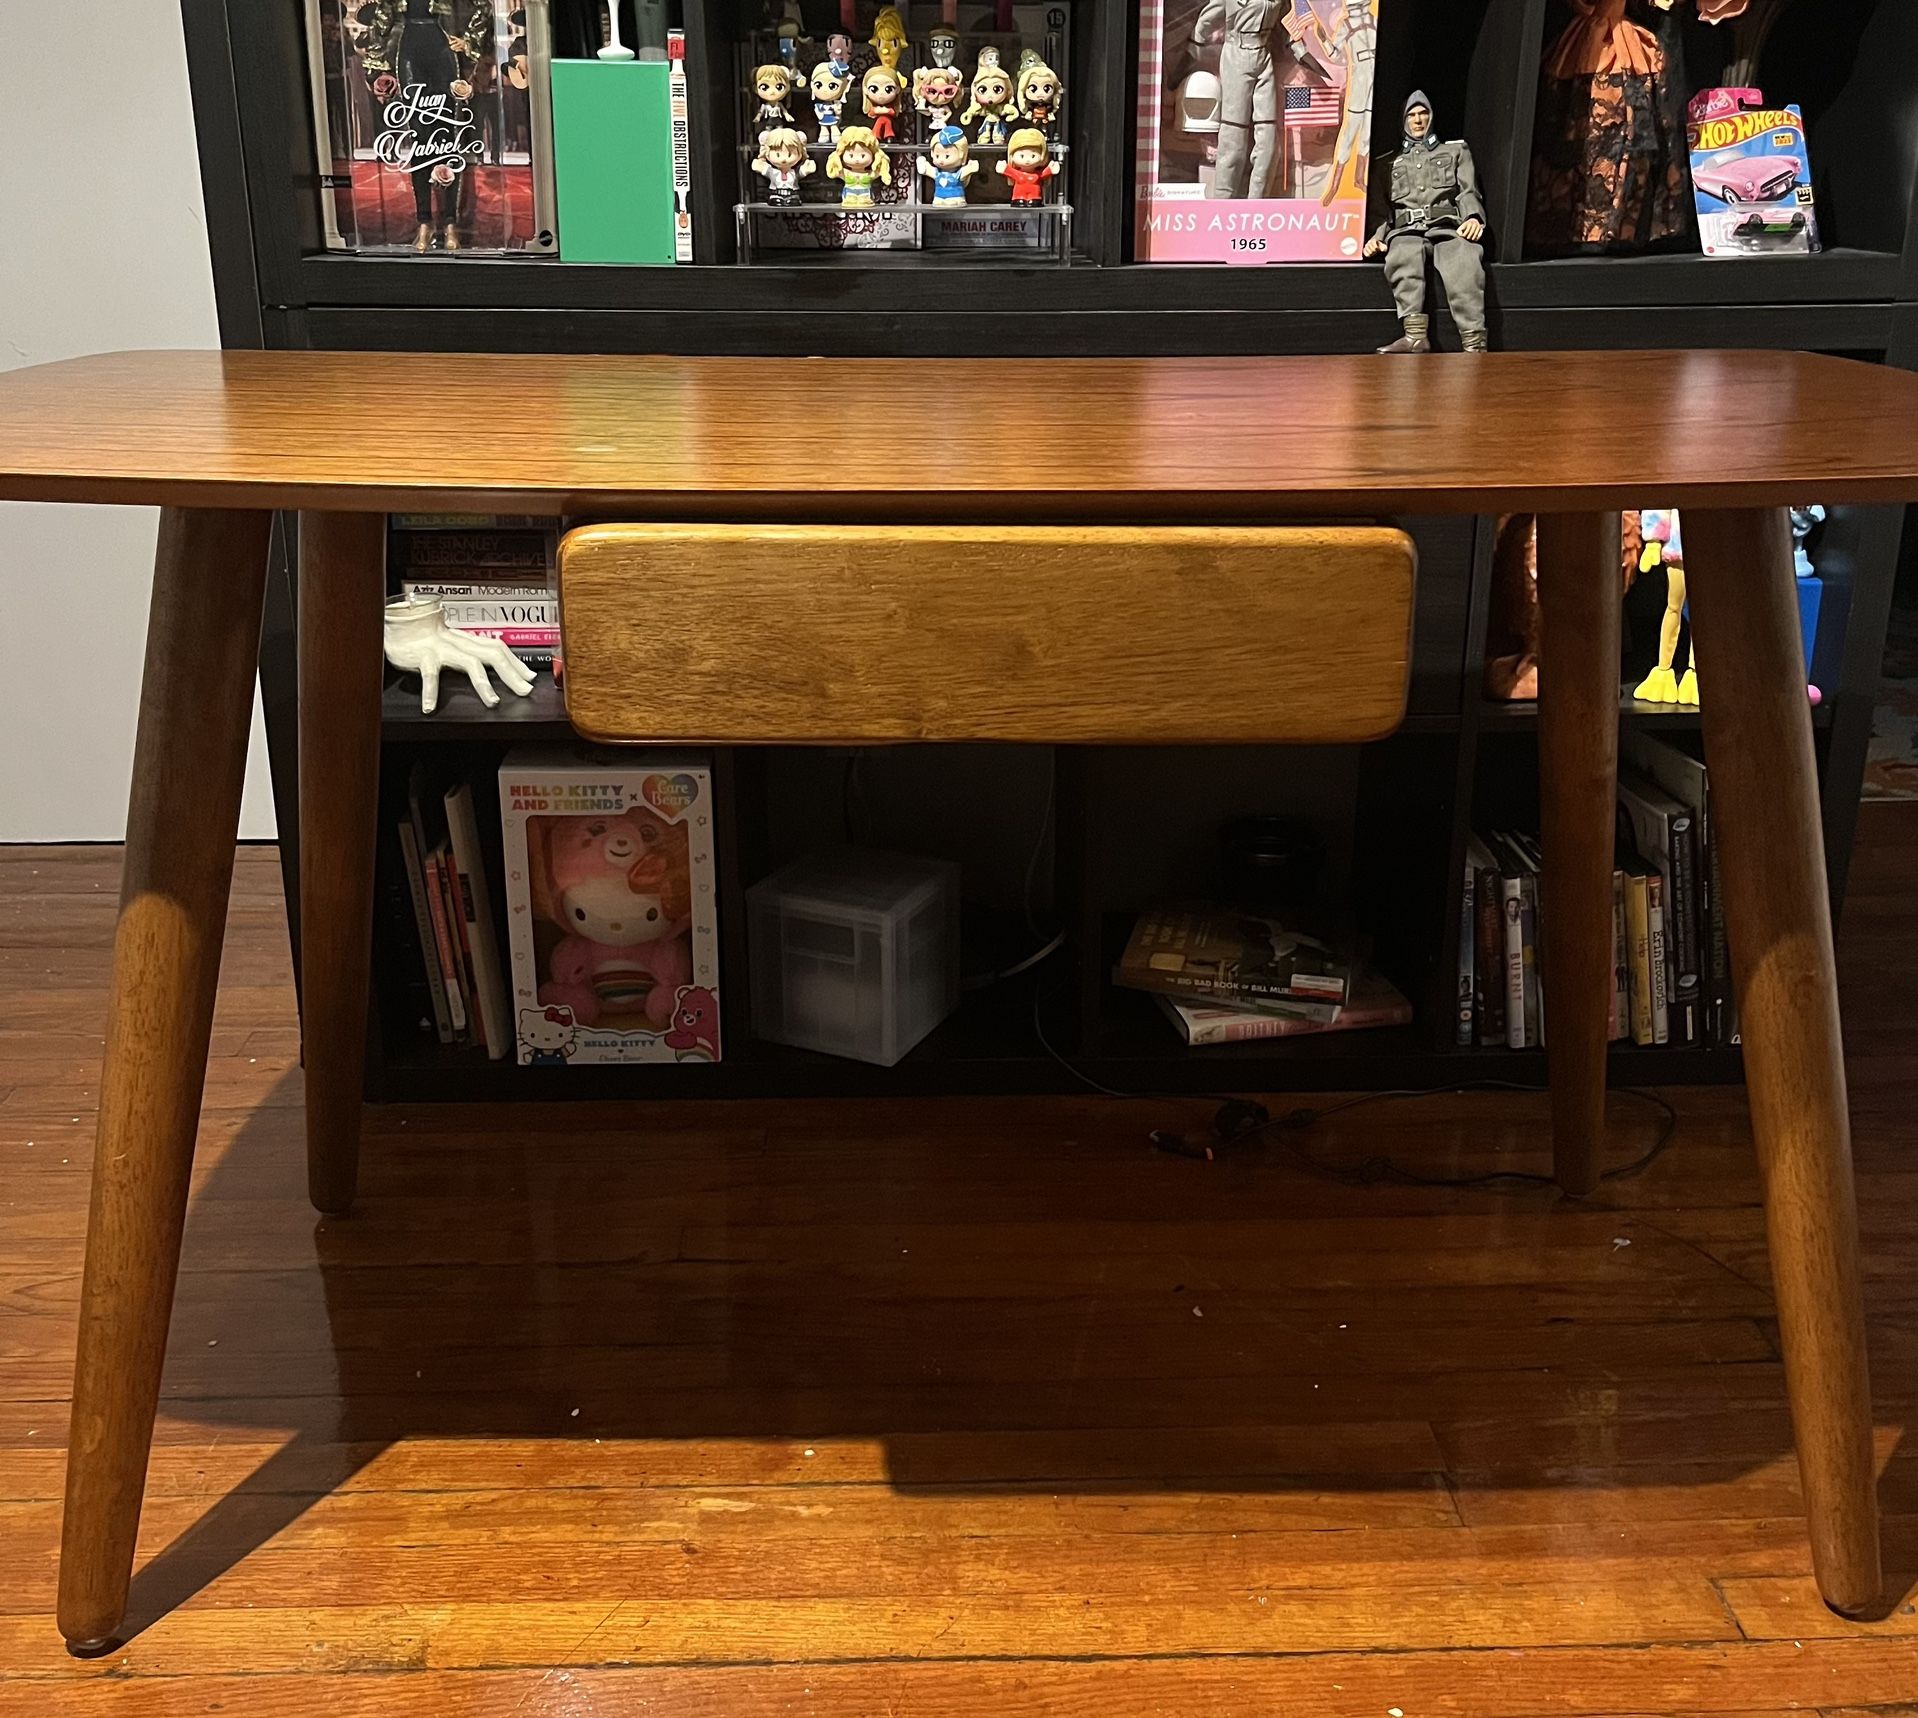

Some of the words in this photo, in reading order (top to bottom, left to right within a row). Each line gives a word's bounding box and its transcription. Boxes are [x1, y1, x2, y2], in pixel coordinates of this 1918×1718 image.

[671, 82, 684, 98] THE
[383, 83, 473, 128] Juan
[672, 100, 685, 118] FIVE
[373, 124, 484, 173] Gabriel
[673, 120, 688, 188] OBSTRUCTIONS
[941, 221, 986, 232] MARIAH
[991, 221, 1027, 232] CAREY
[1143, 213, 1197, 231] MISS
[1231, 238, 1267, 250] 1965
[523, 586, 548, 595] Rom
[500, 606, 559, 623] VOGU
[510, 785, 564, 797] HELLO
[568, 784, 624, 797] KITTY
[512, 799, 549, 811] AND
[552, 799, 624, 810] FRIENDS
[1652, 930, 1664, 958] Erin
[1178, 977, 1192, 985] BIG
[1194, 979, 1211, 987] BAD
[1213, 981, 1239, 990] BOOK
[1251, 984, 1267, 992] BILL
[1269, 986, 1292, 994] MUR
[1509, 952, 1523, 1002] BURNT
[1653, 959, 1666, 1011] Brockovich
